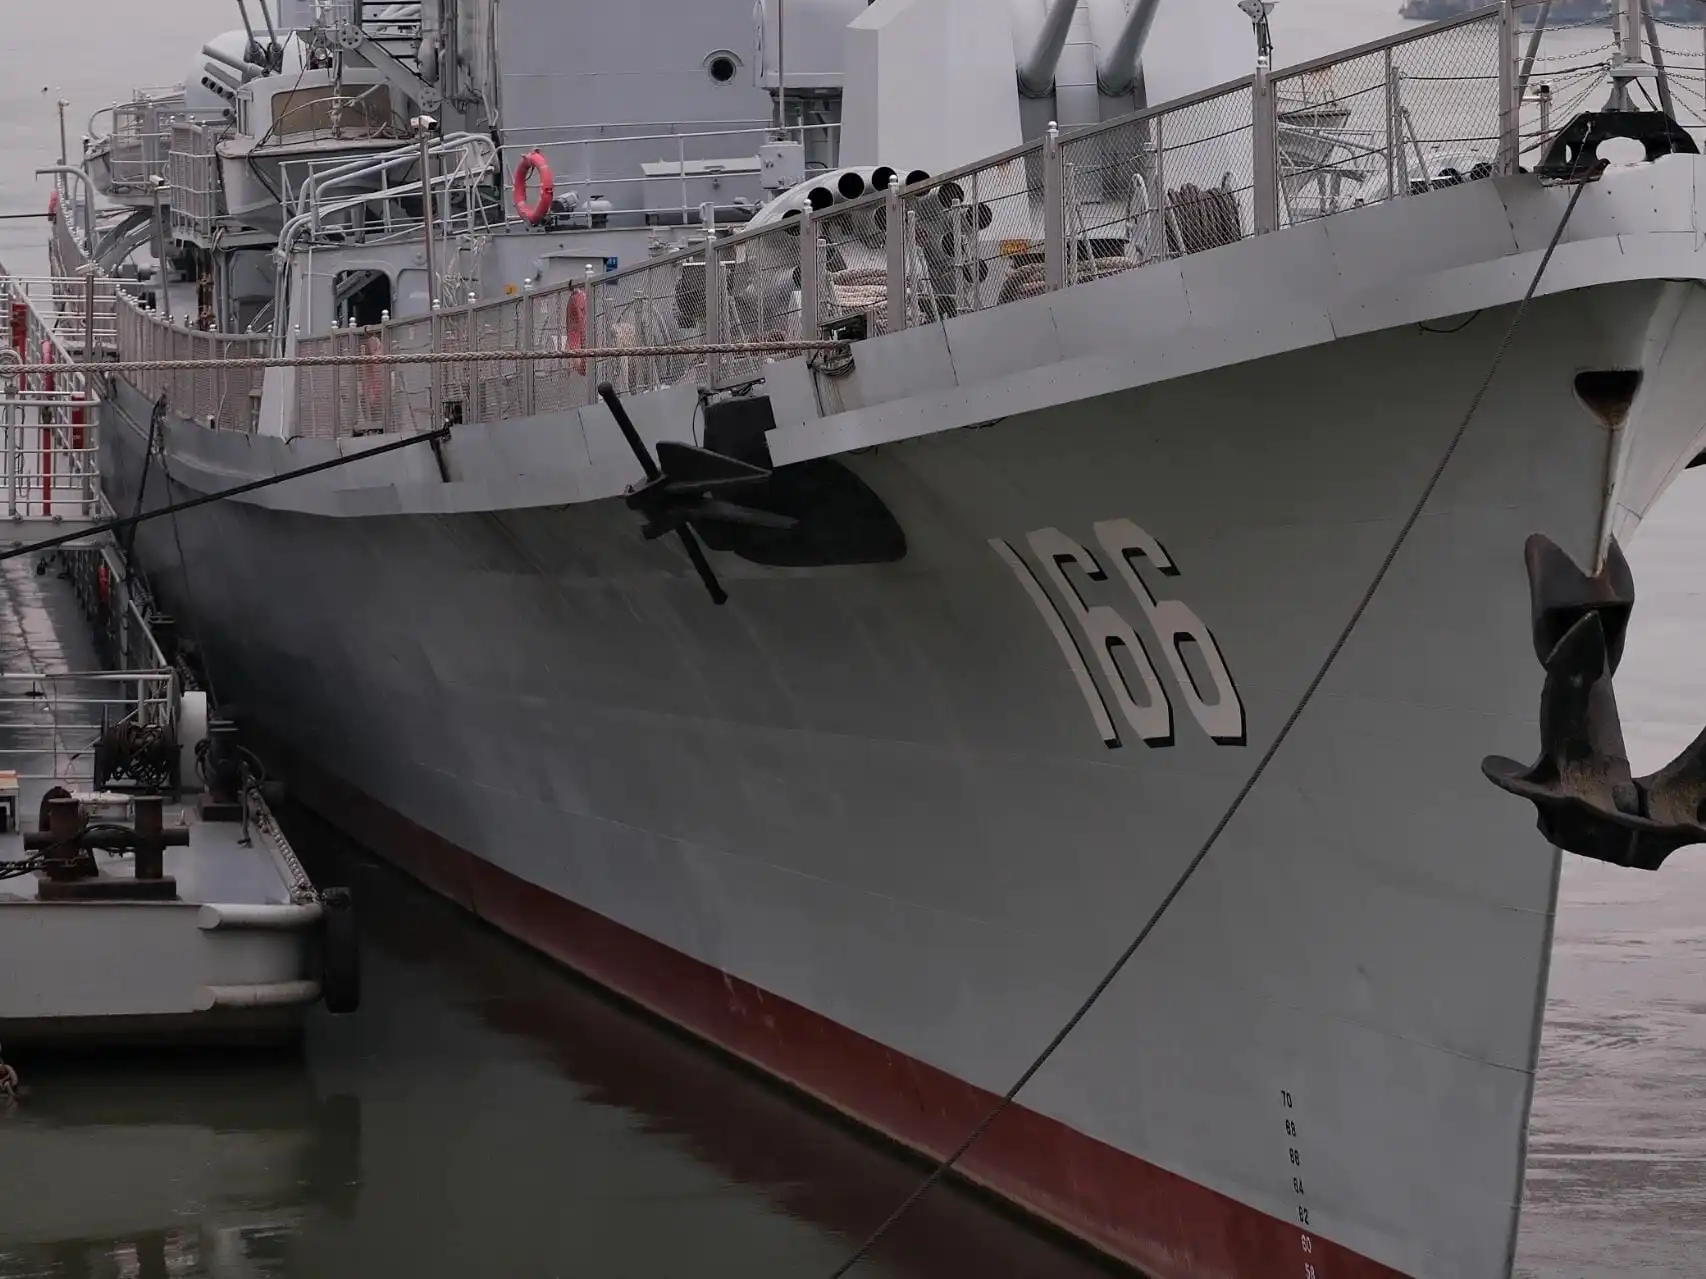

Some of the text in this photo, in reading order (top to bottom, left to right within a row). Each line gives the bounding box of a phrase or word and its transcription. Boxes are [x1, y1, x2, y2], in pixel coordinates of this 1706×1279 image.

[987, 518, 1247, 748] 166
[1281, 1090, 1293, 1108] 70
[1285, 1119, 1297, 1137] 68
[1293, 1176, 1304, 1195] 64
[1298, 1206, 1309, 1225] 62
[1301, 1234, 1311, 1253] 60
[1304, 1262, 1316, 1279] 58
